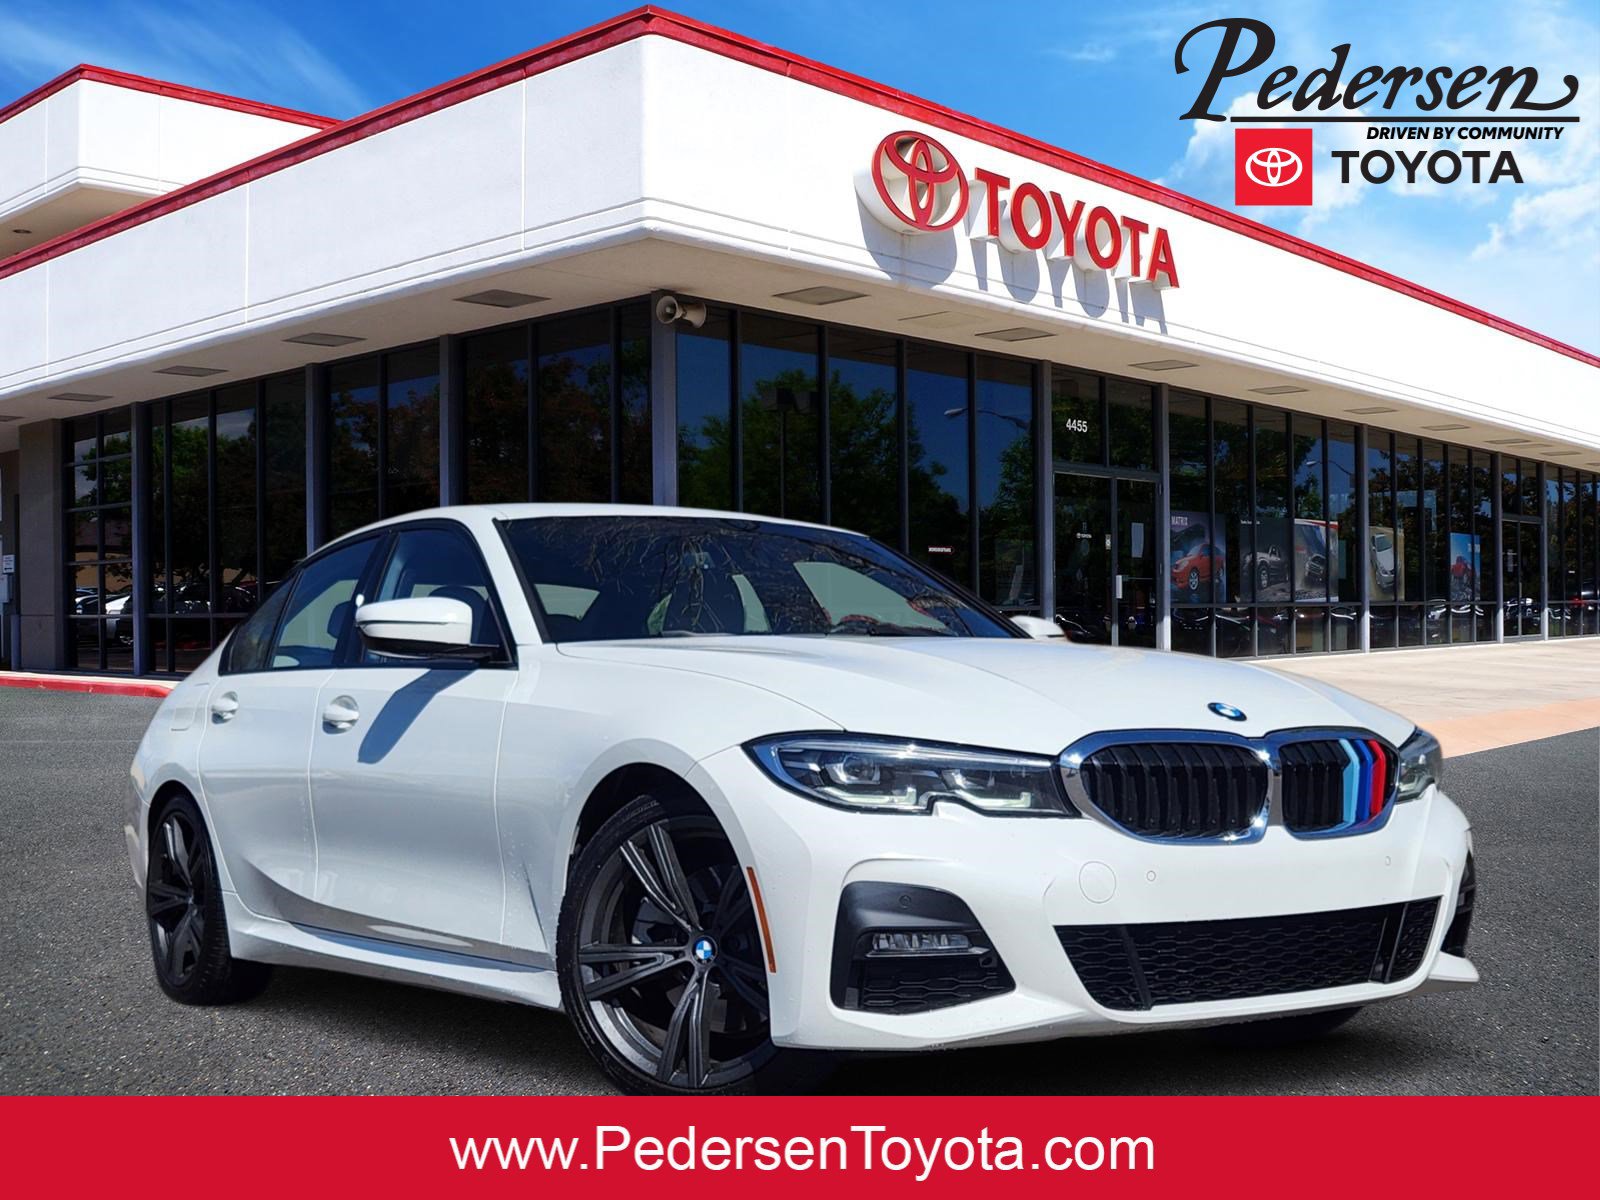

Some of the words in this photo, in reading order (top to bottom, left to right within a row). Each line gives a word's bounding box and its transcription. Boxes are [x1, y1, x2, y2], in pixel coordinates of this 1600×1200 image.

[975, 167, 1180, 288] TOYOTA
[1065, 418, 1088, 433] 4455
[1171, 515, 1189, 527] MATRIX
